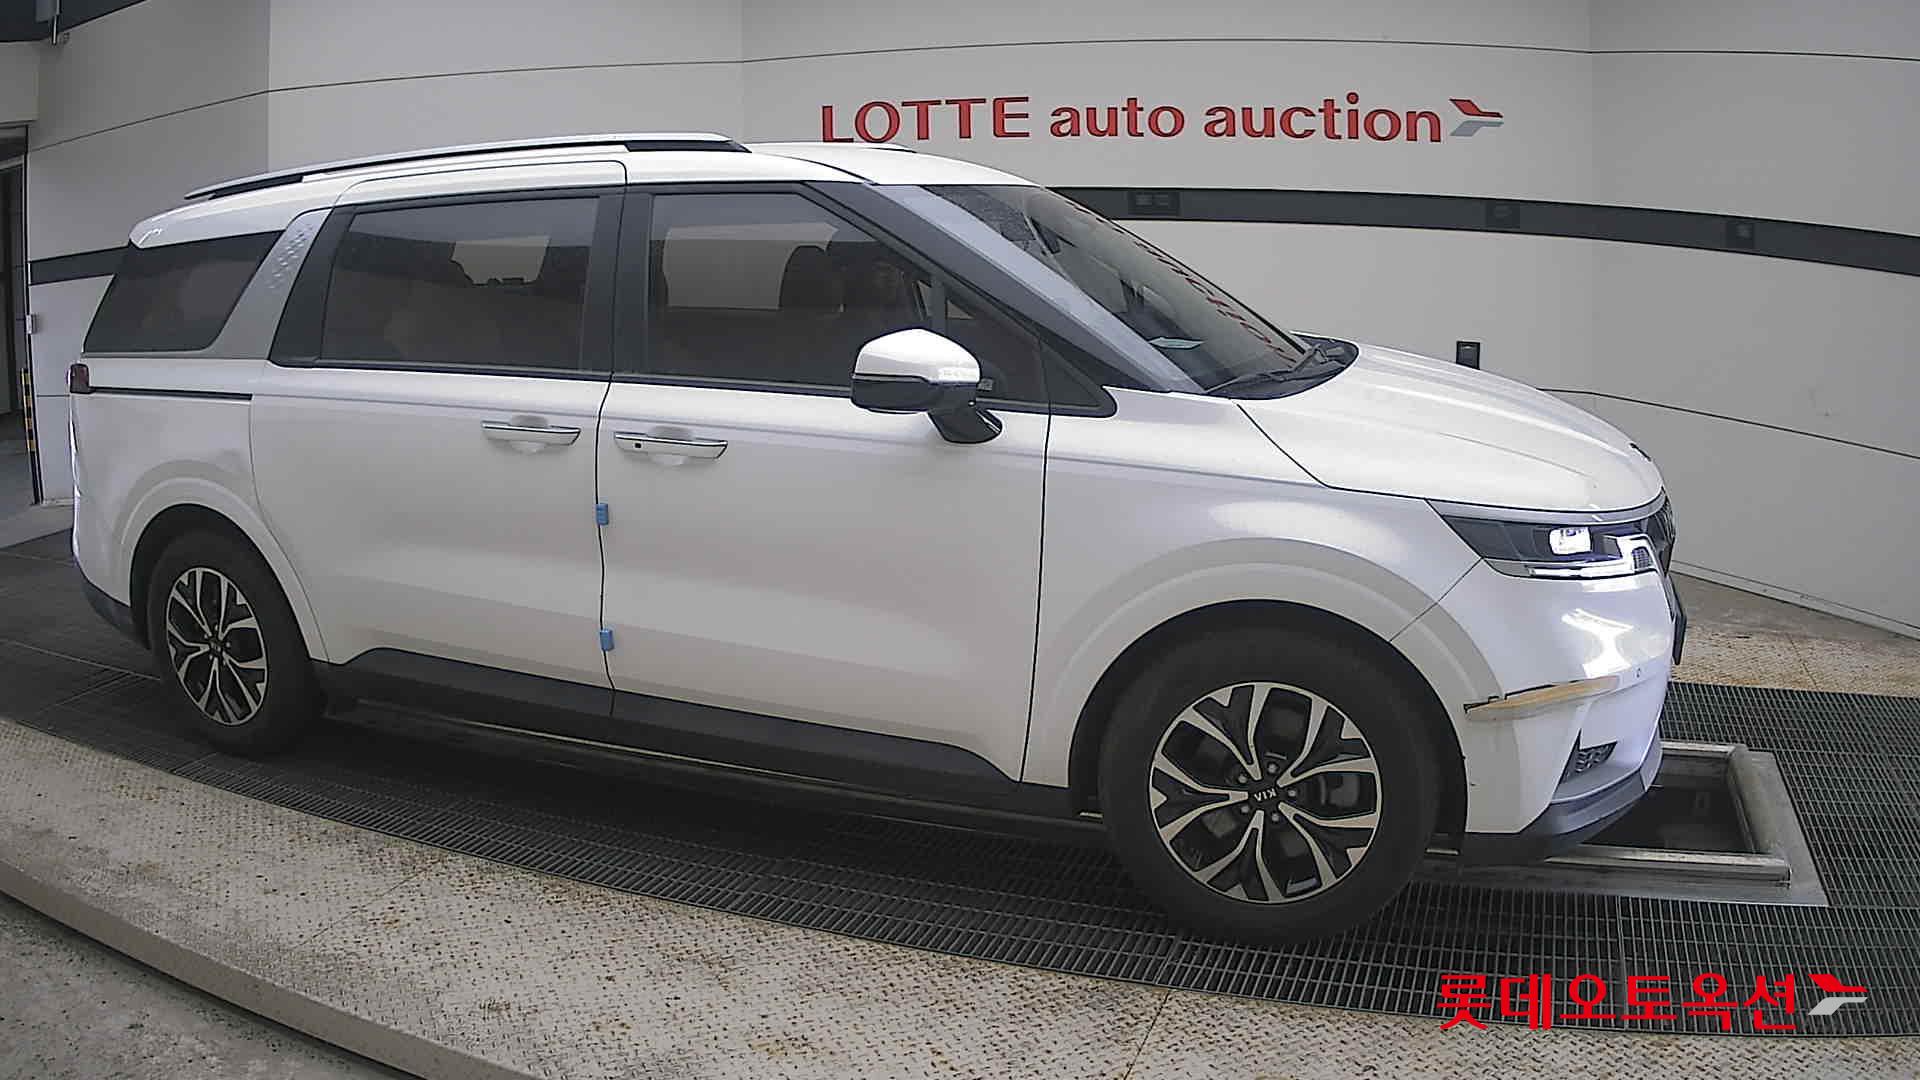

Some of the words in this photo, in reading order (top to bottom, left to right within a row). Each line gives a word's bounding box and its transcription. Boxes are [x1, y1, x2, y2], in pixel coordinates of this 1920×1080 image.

[821, 97, 1031, 143] LOTTE
[1049, 97, 1185, 138] auto
[1203, 91, 1442, 142] auction
[1253, 787, 1277, 801] KIA
